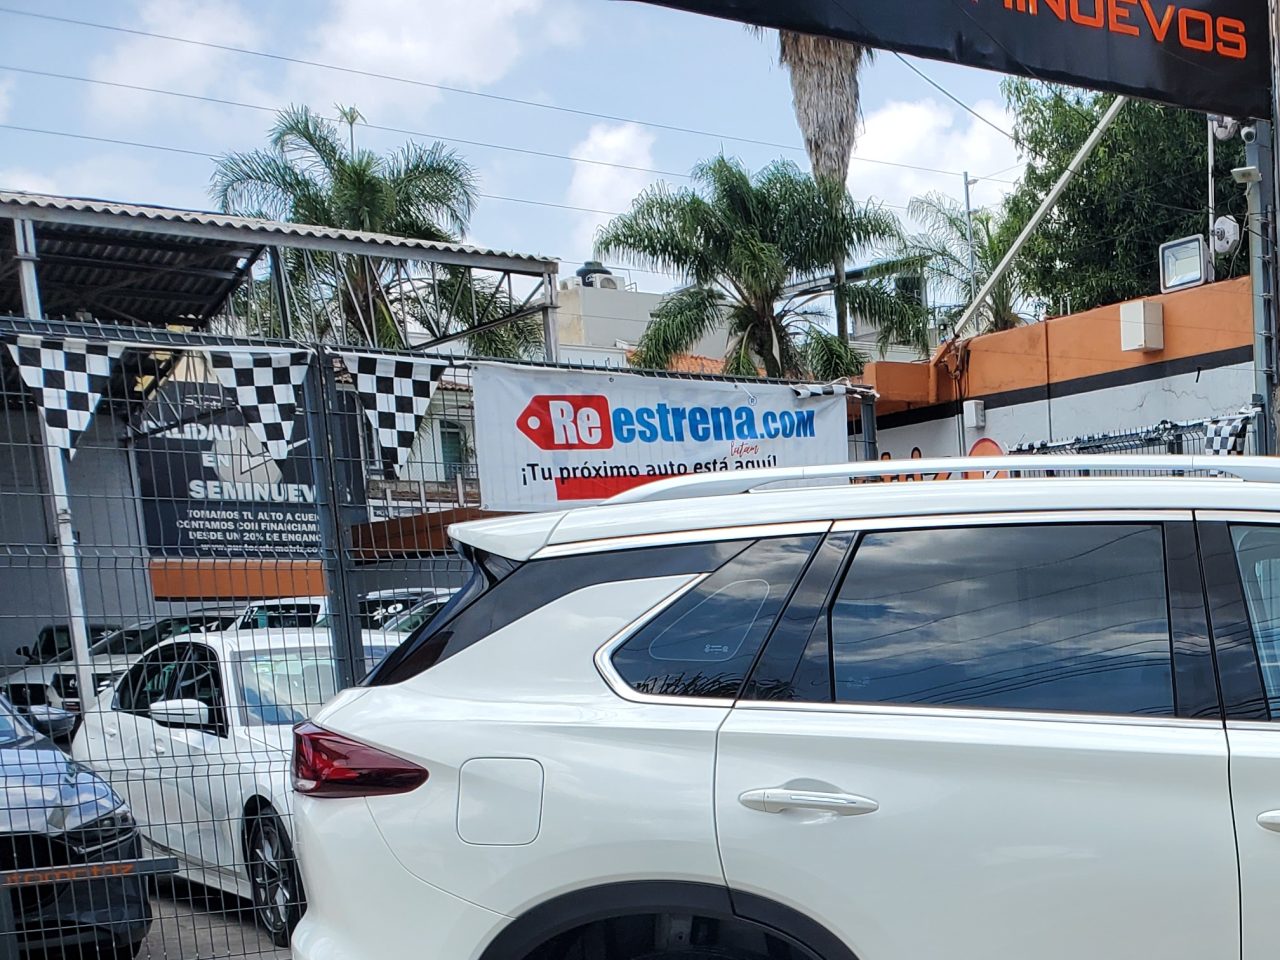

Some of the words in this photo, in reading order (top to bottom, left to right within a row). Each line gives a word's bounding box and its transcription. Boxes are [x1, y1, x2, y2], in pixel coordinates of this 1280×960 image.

[202, 451, 231, 467] EN
[558, 460, 640, 485] próximo
[645, 461, 688, 478] auto
[693, 456, 729, 474] está
[188, 480, 319, 503] SEMINUEV
[187, 510, 239, 520] TOMAMOS
[286, 513, 293, 522] A
[176, 520, 235, 530] CONTAMOS
[237, 522, 259, 531] CON
[188, 531, 224, 540] DESDE
[226, 532, 241, 541] UN
[243, 533, 264, 541] 20%
[266, 534, 280, 542] DE
